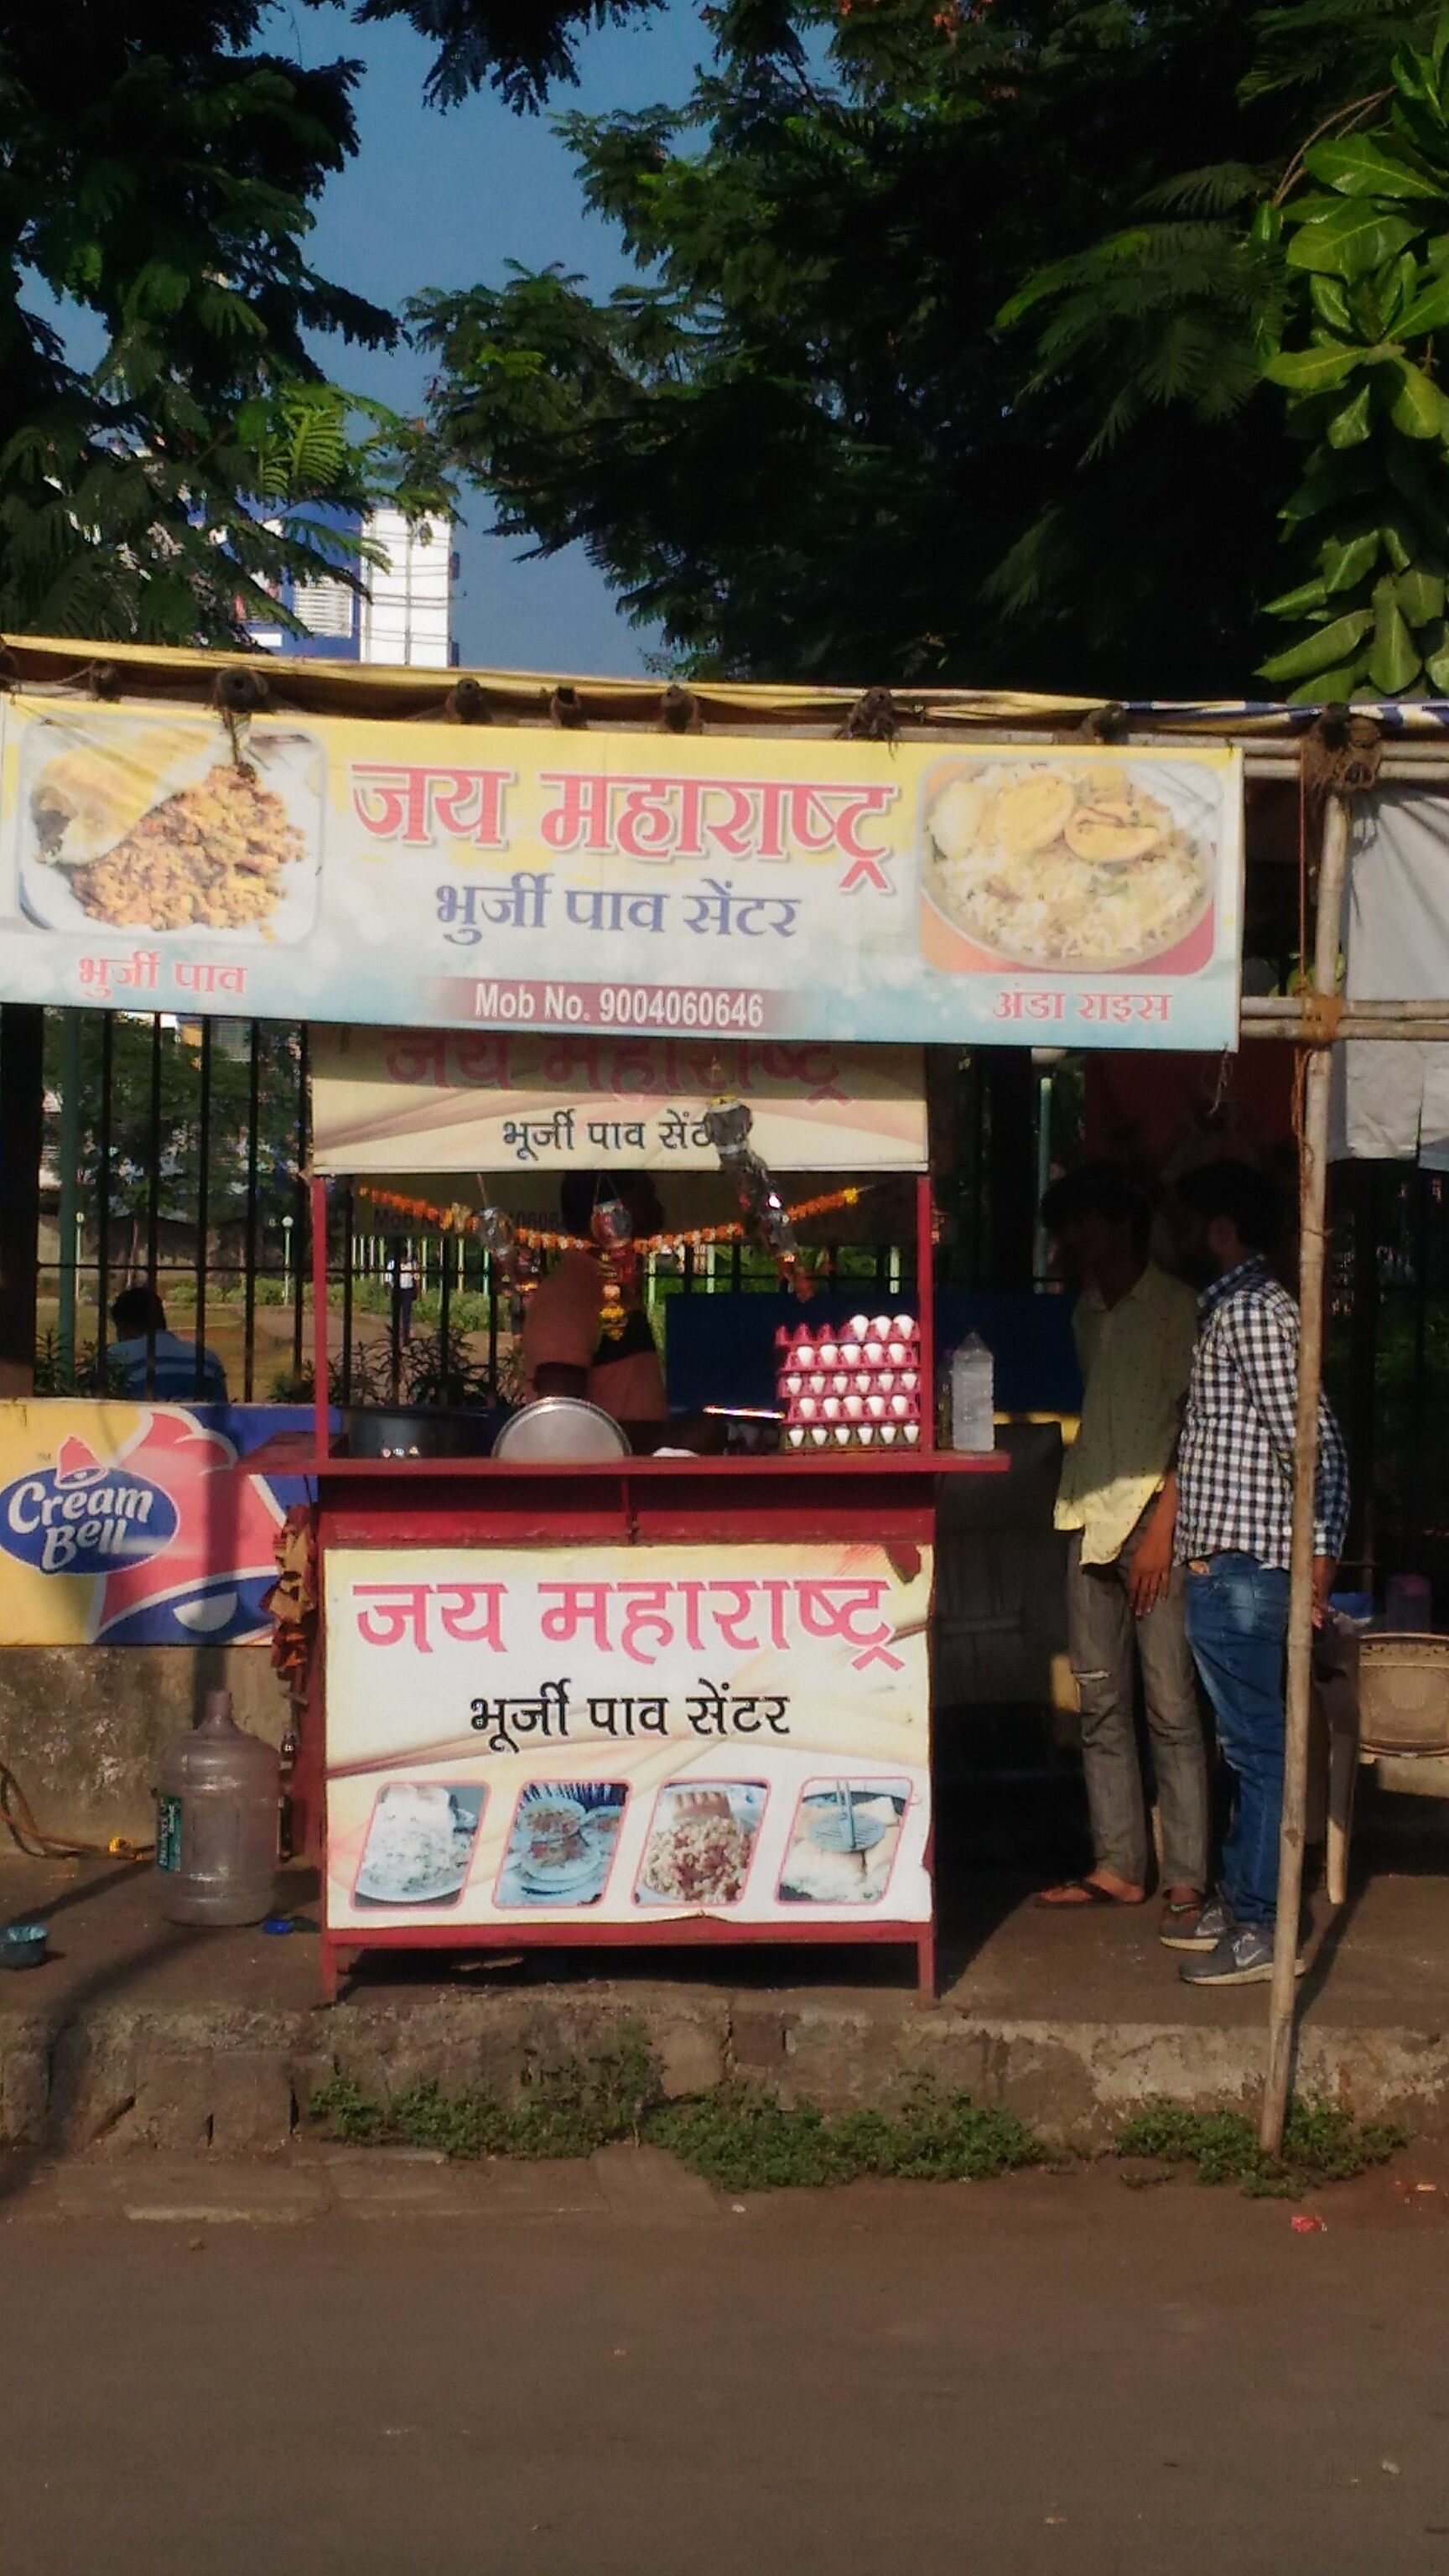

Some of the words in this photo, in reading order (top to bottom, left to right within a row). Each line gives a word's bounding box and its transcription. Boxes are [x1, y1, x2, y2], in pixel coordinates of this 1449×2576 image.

[352, 762, 517, 849] जय
[540, 769, 899, 894] महाराष्ट्र
[565, 887, 669, 932] पाव
[683, 879, 801, 937] सेंटर
[174, 962, 247, 994] पाव
[475, 983, 534, 1019] Mob
[544, 985, 590, 1021] No.
[600, 988, 764, 1028] 9004060646
[1076, 992, 1172, 1023] राइस
[382, 1029, 512, 1089] जय
[503, 1109, 575, 1161] भूर्जी
[588, 1119, 645, 1150] पाव
[659, 1109, 710, 1150] सेंट
[8, 1481, 153, 1534] Cream
[41, 1518, 127, 1571] Bell
[351, 1582, 507, 1654] जय
[538, 1577, 905, 1672] महाराष्ट्र
[470, 1679, 571, 1754] भूर्जी
[589, 1696, 668, 1737] पाव
[686, 1679, 791, 1736] सेंटर
